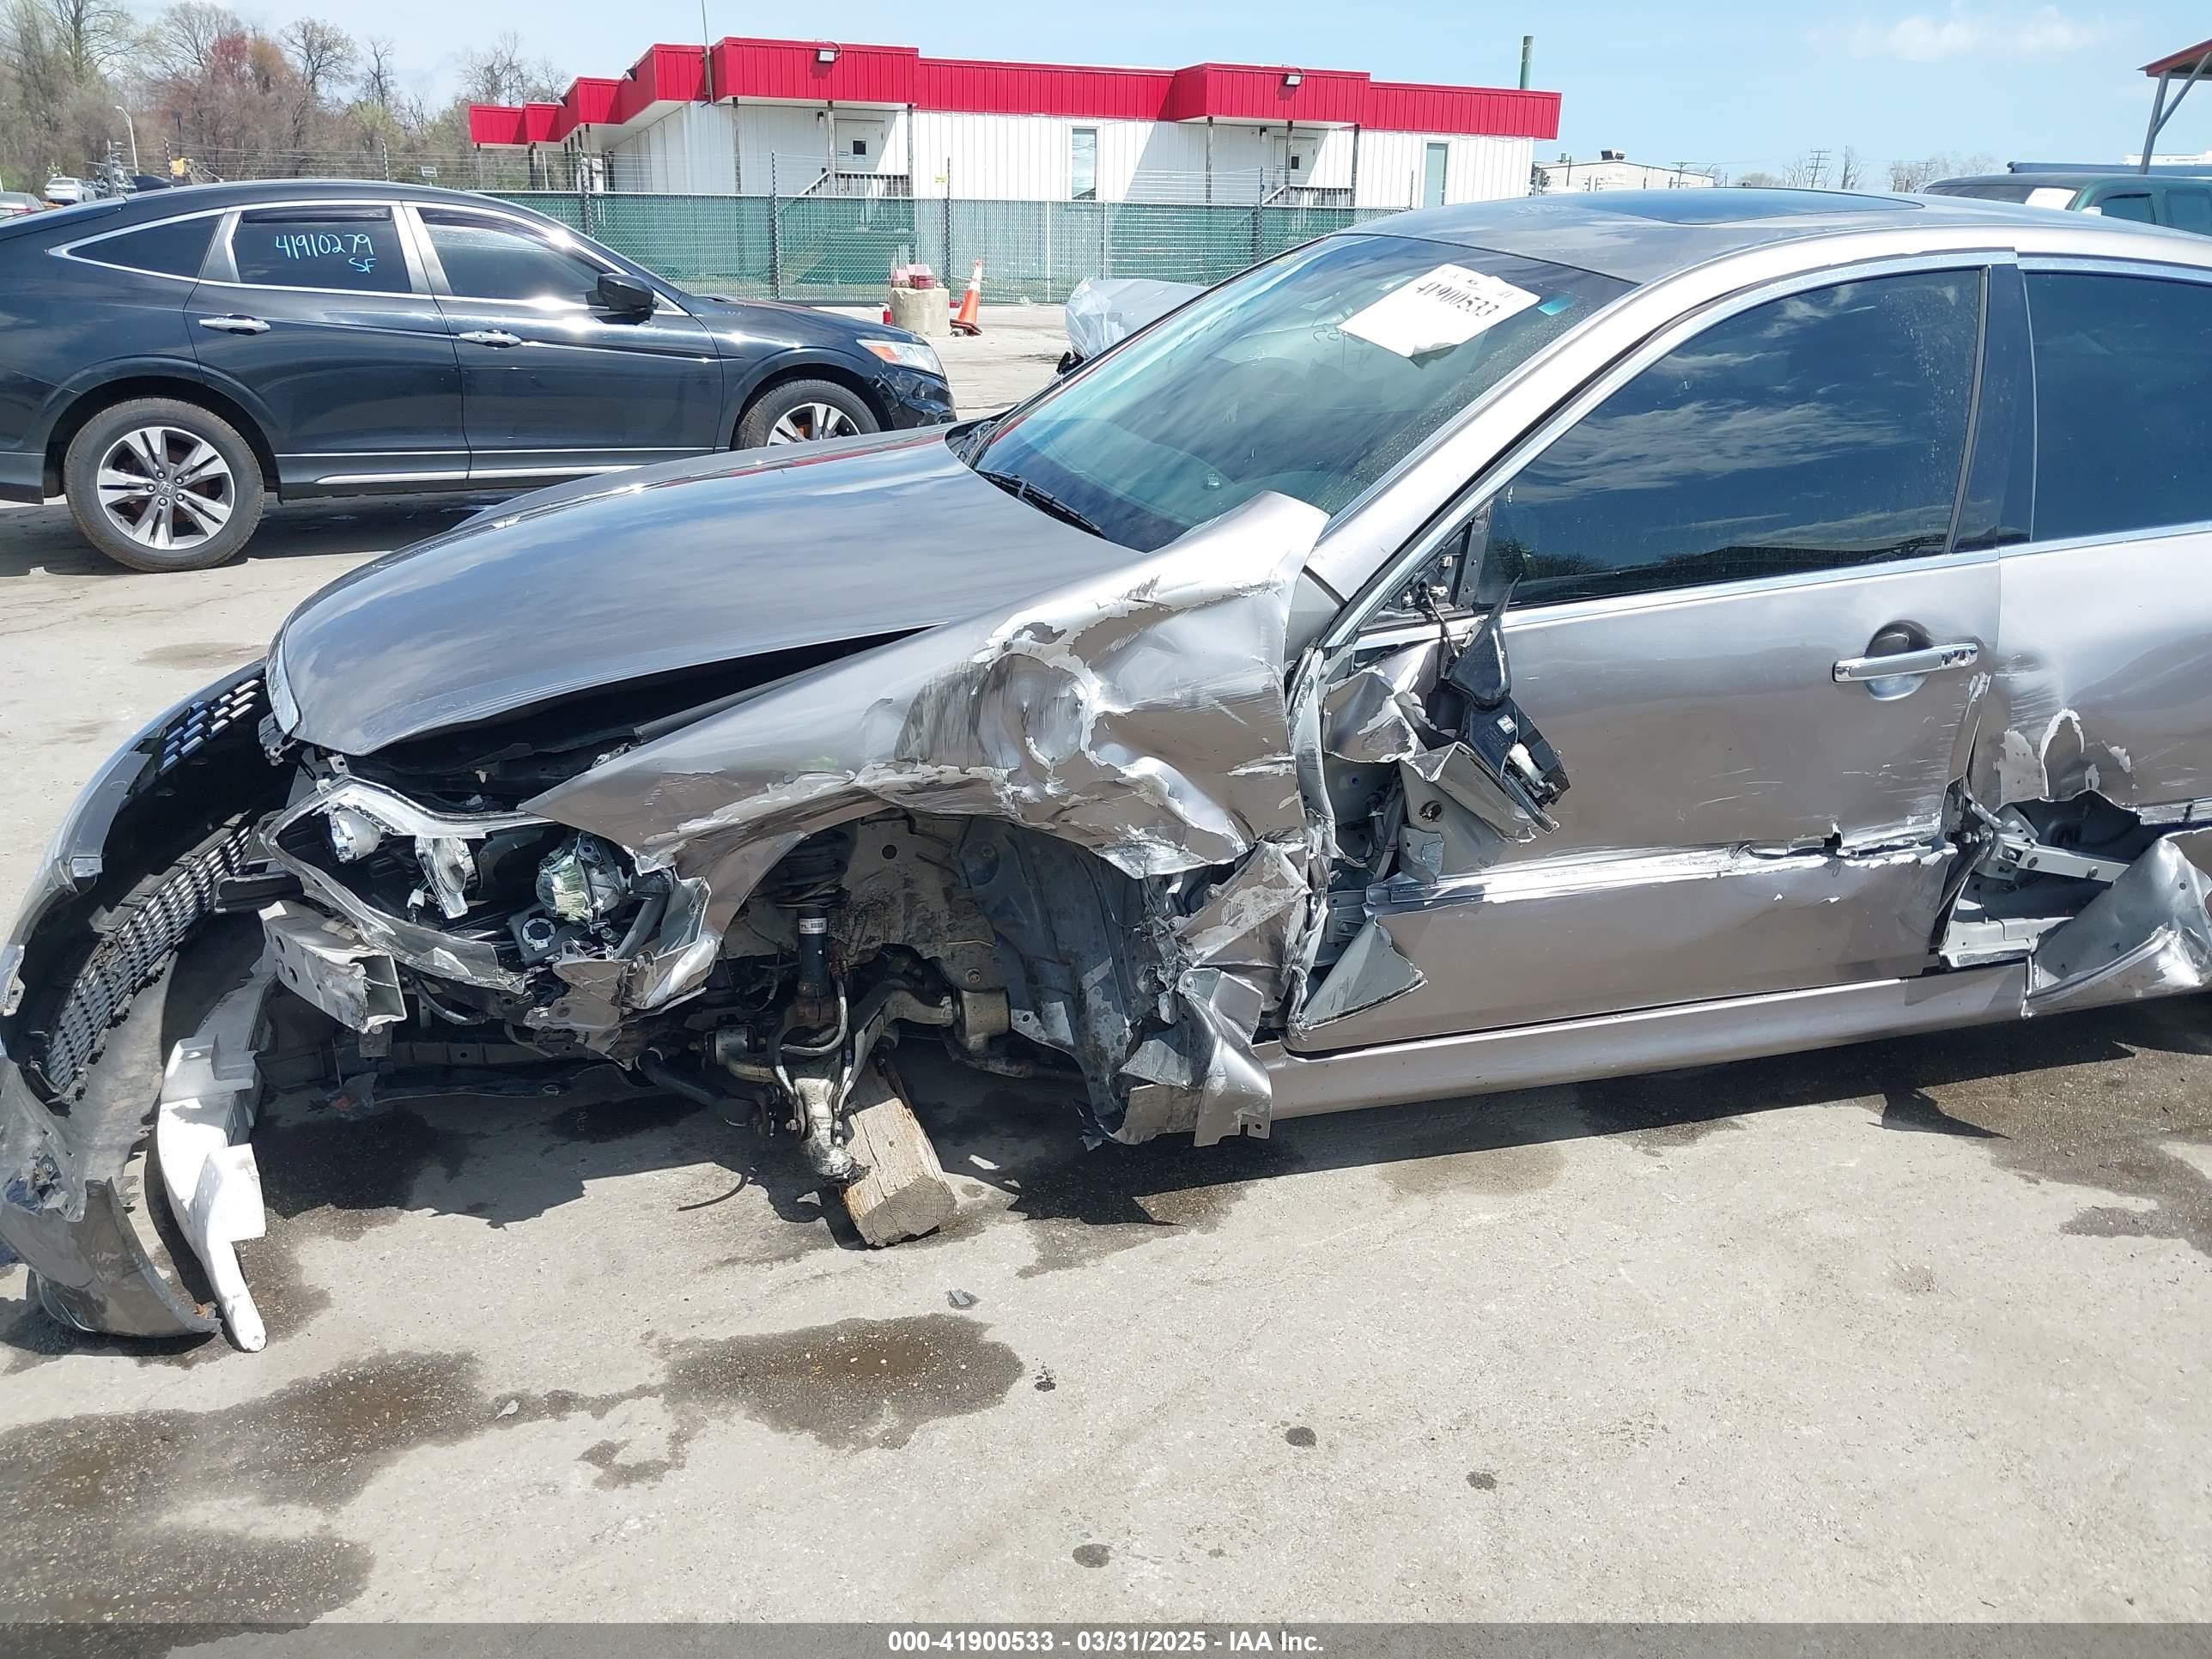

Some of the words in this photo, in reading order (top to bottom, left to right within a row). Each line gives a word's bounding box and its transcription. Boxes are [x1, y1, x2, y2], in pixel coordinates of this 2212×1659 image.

[276, 234, 374, 259] 41910279
[348, 258, 377, 273] SF
[1416, 281, 1499, 317] 41900533
